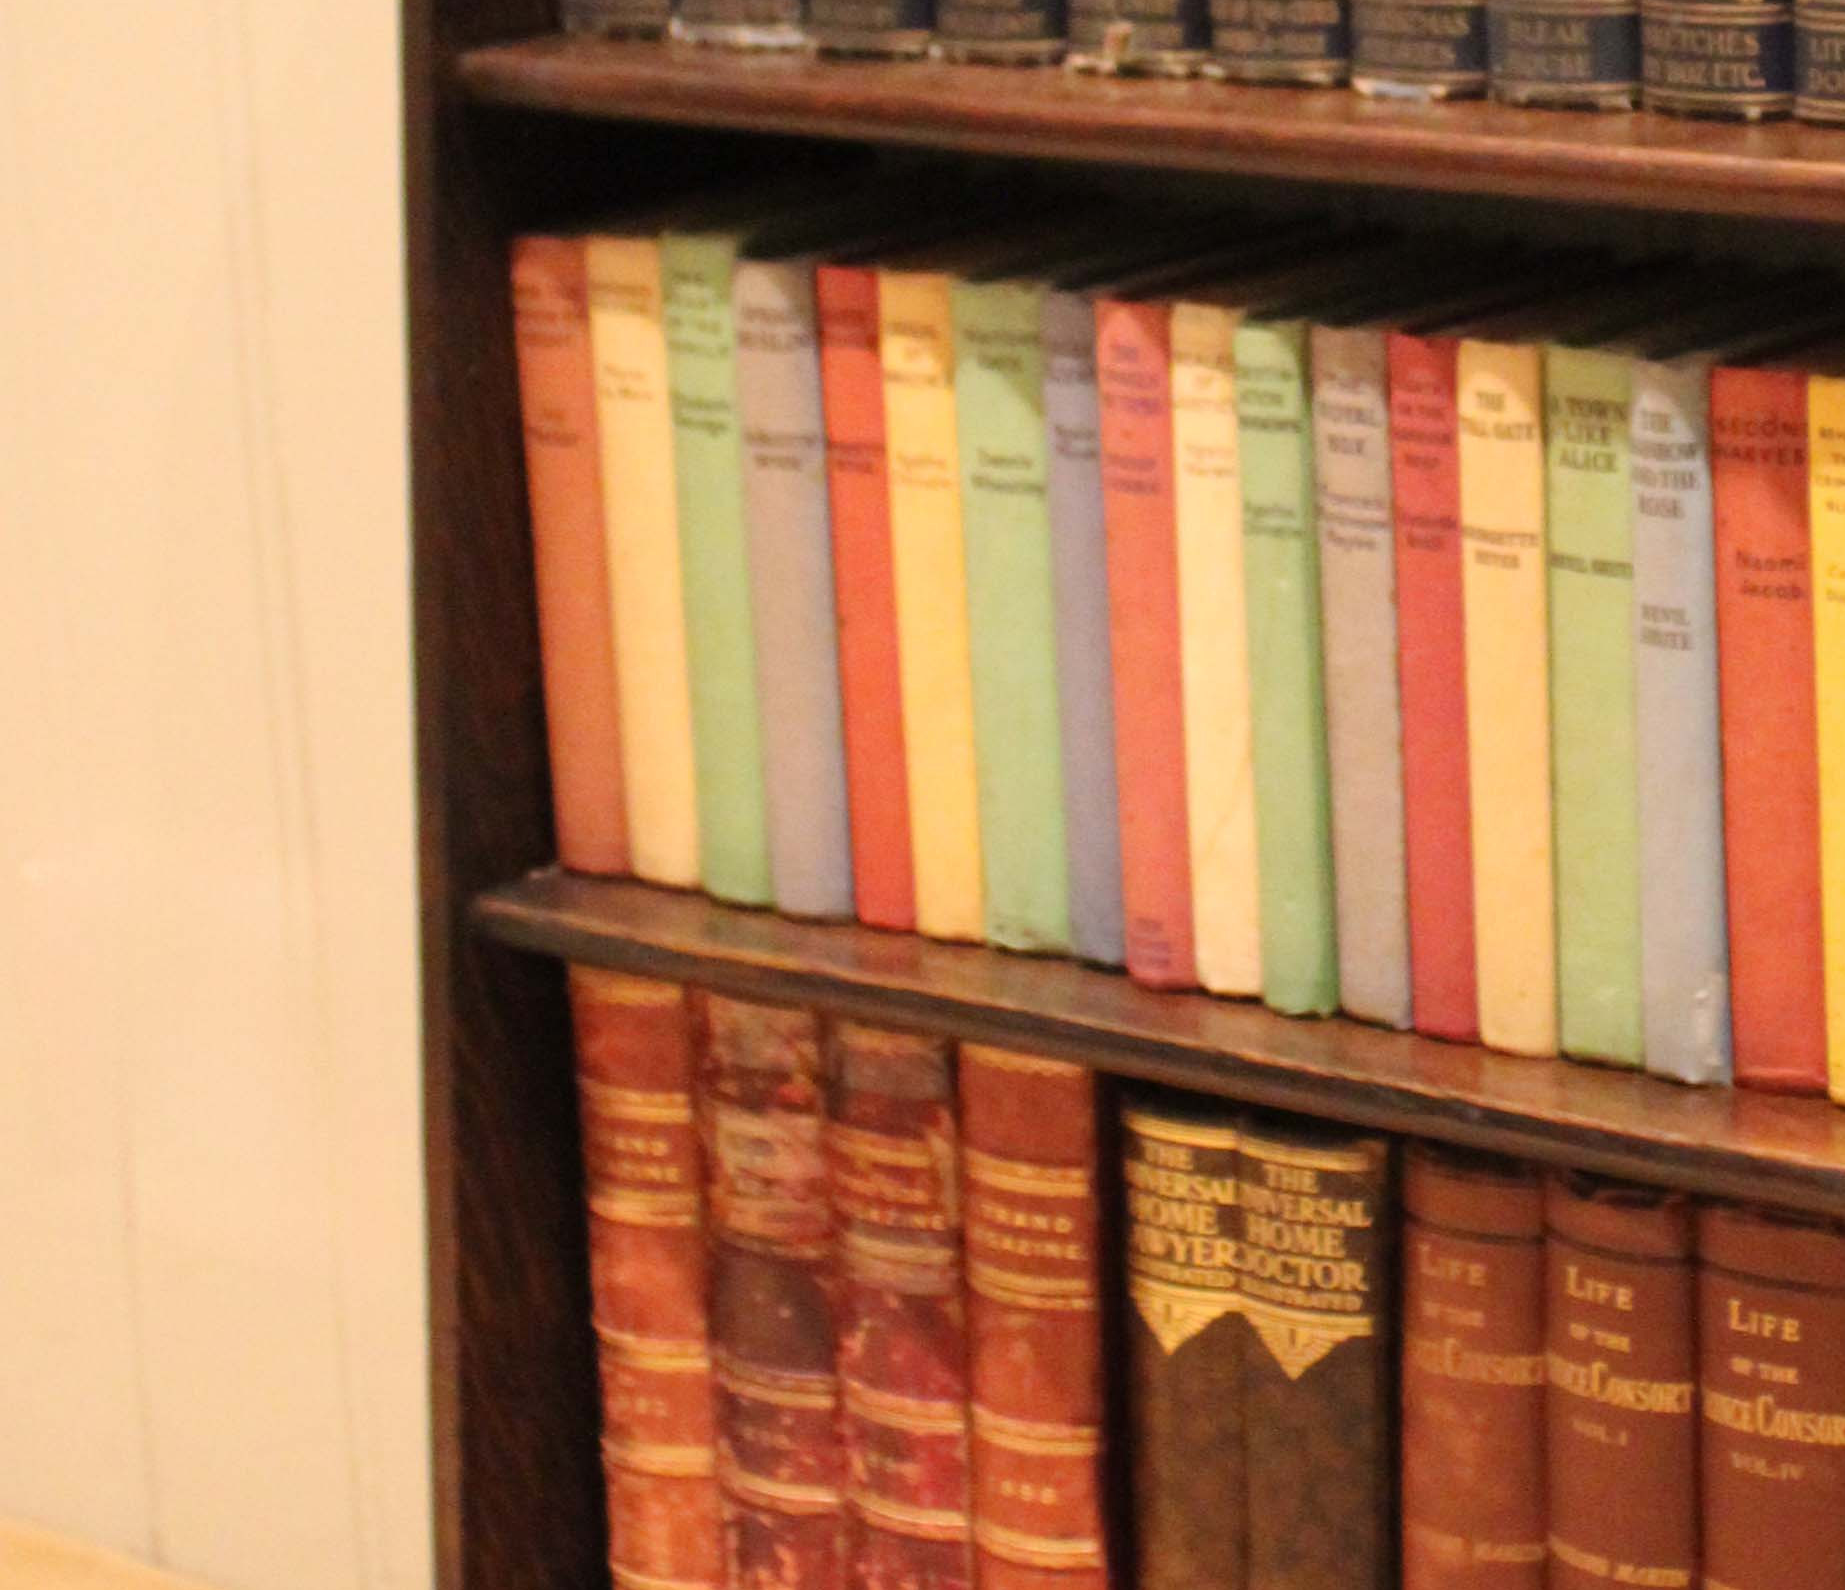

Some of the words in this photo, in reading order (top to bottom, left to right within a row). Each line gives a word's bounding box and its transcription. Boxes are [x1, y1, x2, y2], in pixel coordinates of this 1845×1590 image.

[1262, 1162, 1320, 1195] THE
[1565, 1265, 1634, 1311] LIFE
[1728, 1298, 1801, 1343] LIFE
